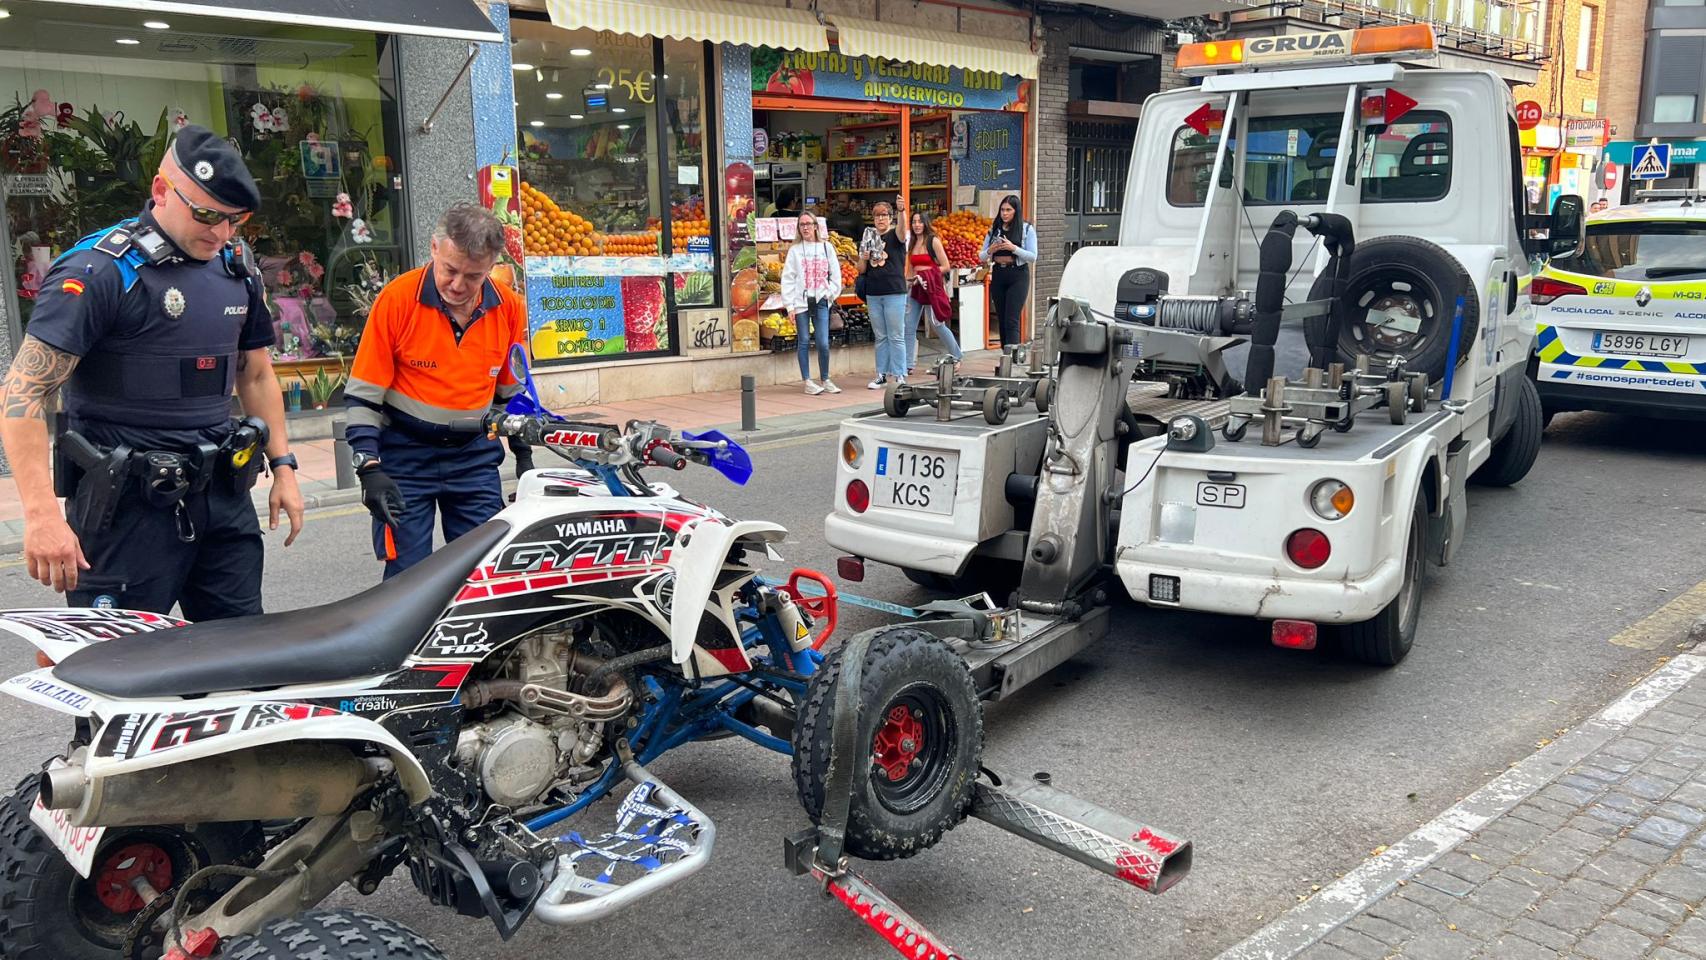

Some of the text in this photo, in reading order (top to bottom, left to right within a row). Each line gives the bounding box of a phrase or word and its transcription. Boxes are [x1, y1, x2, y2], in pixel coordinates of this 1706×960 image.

[1249, 33, 1345, 54] GRUA
[962, 67, 1003, 90] ASIA
[864, 81, 964, 107] AUTOSERVICIO
[974, 128, 1009, 151] FRUTA
[983, 159, 998, 181] DE
[542, 296, 578, 311] TODOS
[579, 295, 598, 310] LOS
[1618, 310, 1664, 318] SCENIC
[555, 318, 593, 332] SERVICIO
[1603, 334, 1683, 352] 5896 LGY
[410, 359, 437, 369] GRUA
[1576, 372, 1695, 388] #somospartedeti
[544, 429, 599, 447] WRP
[898, 452, 946, 479] 1136
[892, 481, 931, 507] KCS
[554, 519, 627, 538] YAMAHA
[493, 532, 672, 574] GYTR
[440, 642, 496, 655] FOX
